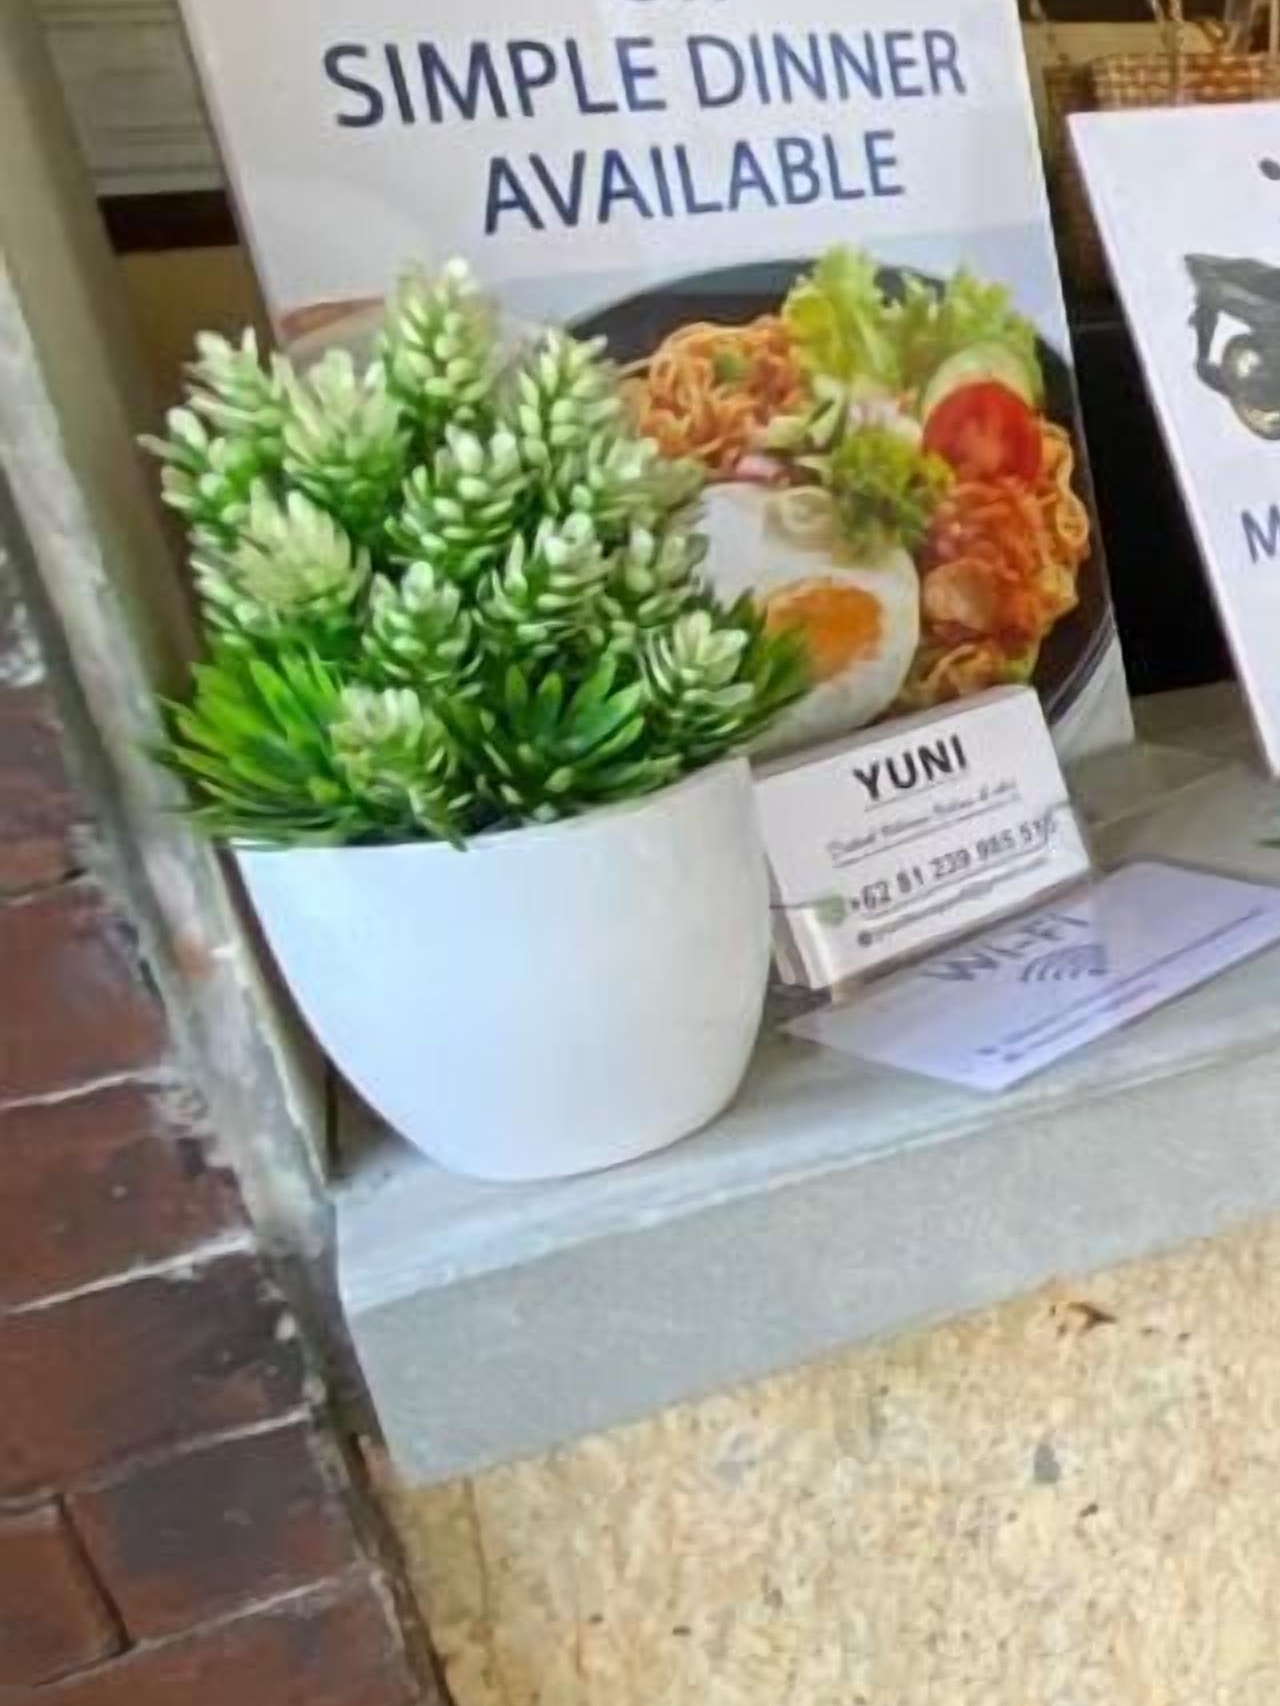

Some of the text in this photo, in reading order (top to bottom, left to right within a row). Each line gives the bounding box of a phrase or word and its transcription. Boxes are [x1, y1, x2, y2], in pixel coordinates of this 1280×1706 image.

[322, 28, 967, 128] SIMPLE DINNER
[482, 130, 905, 237] AVAILABLE
[853, 733, 968, 800] YUNI
